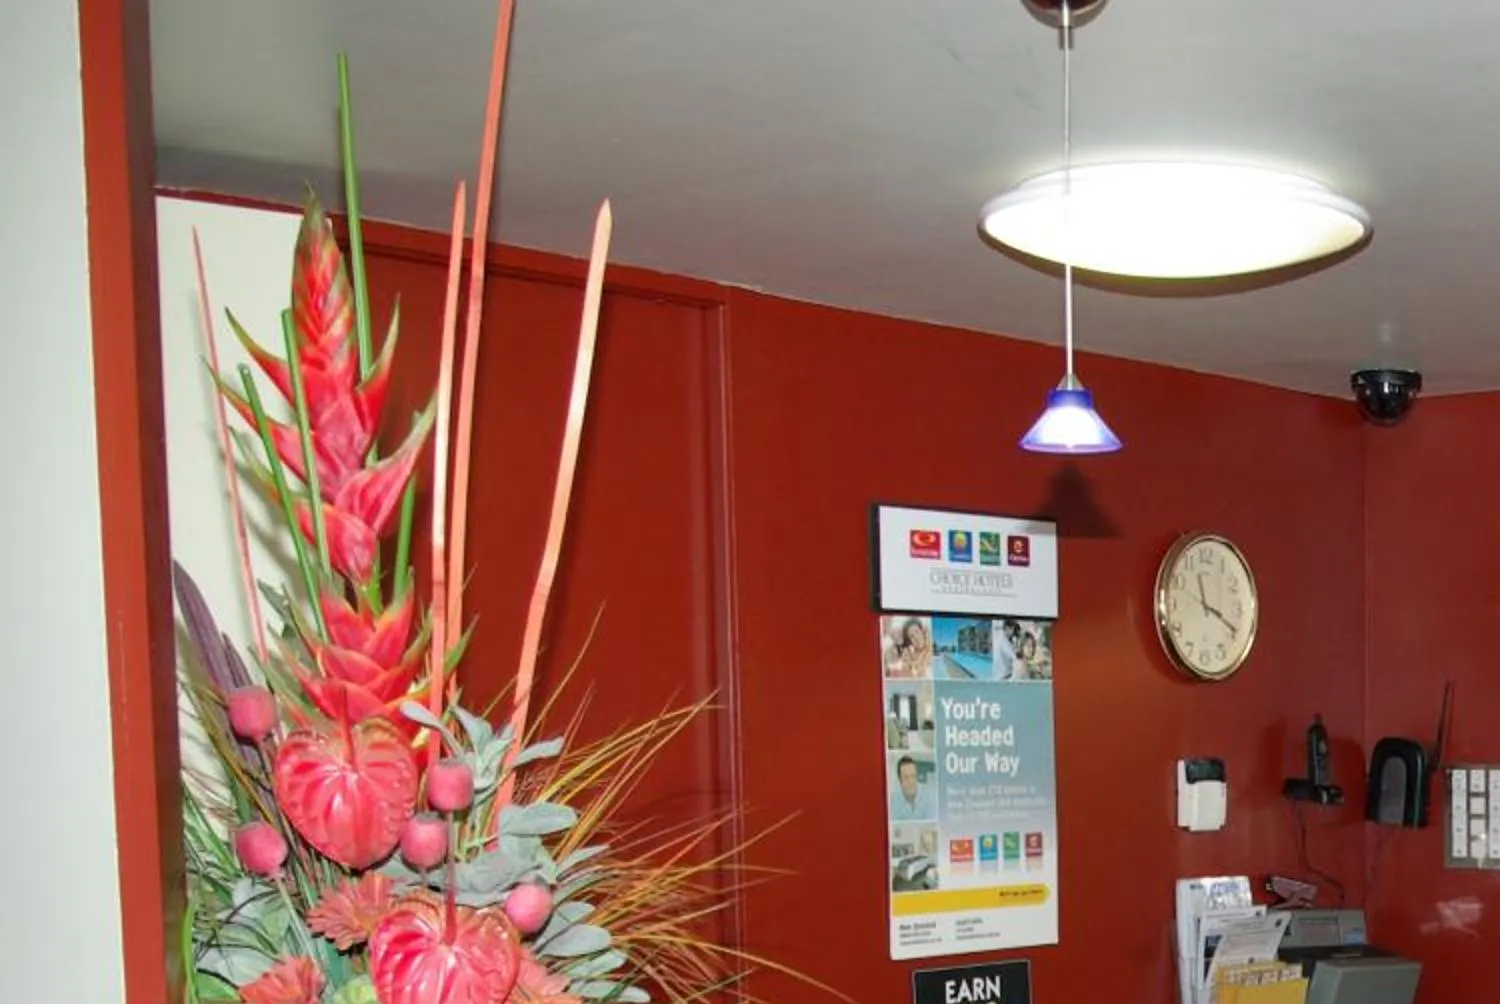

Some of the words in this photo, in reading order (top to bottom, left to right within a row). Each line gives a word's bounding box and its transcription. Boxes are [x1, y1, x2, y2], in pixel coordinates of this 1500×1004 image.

[941, 696, 1001, 720] You're
[945, 725, 1015, 747] Headed
[946, 752, 979, 775] Our
[985, 751, 1020, 778] Way
[945, 975, 1001, 1004] EARN
